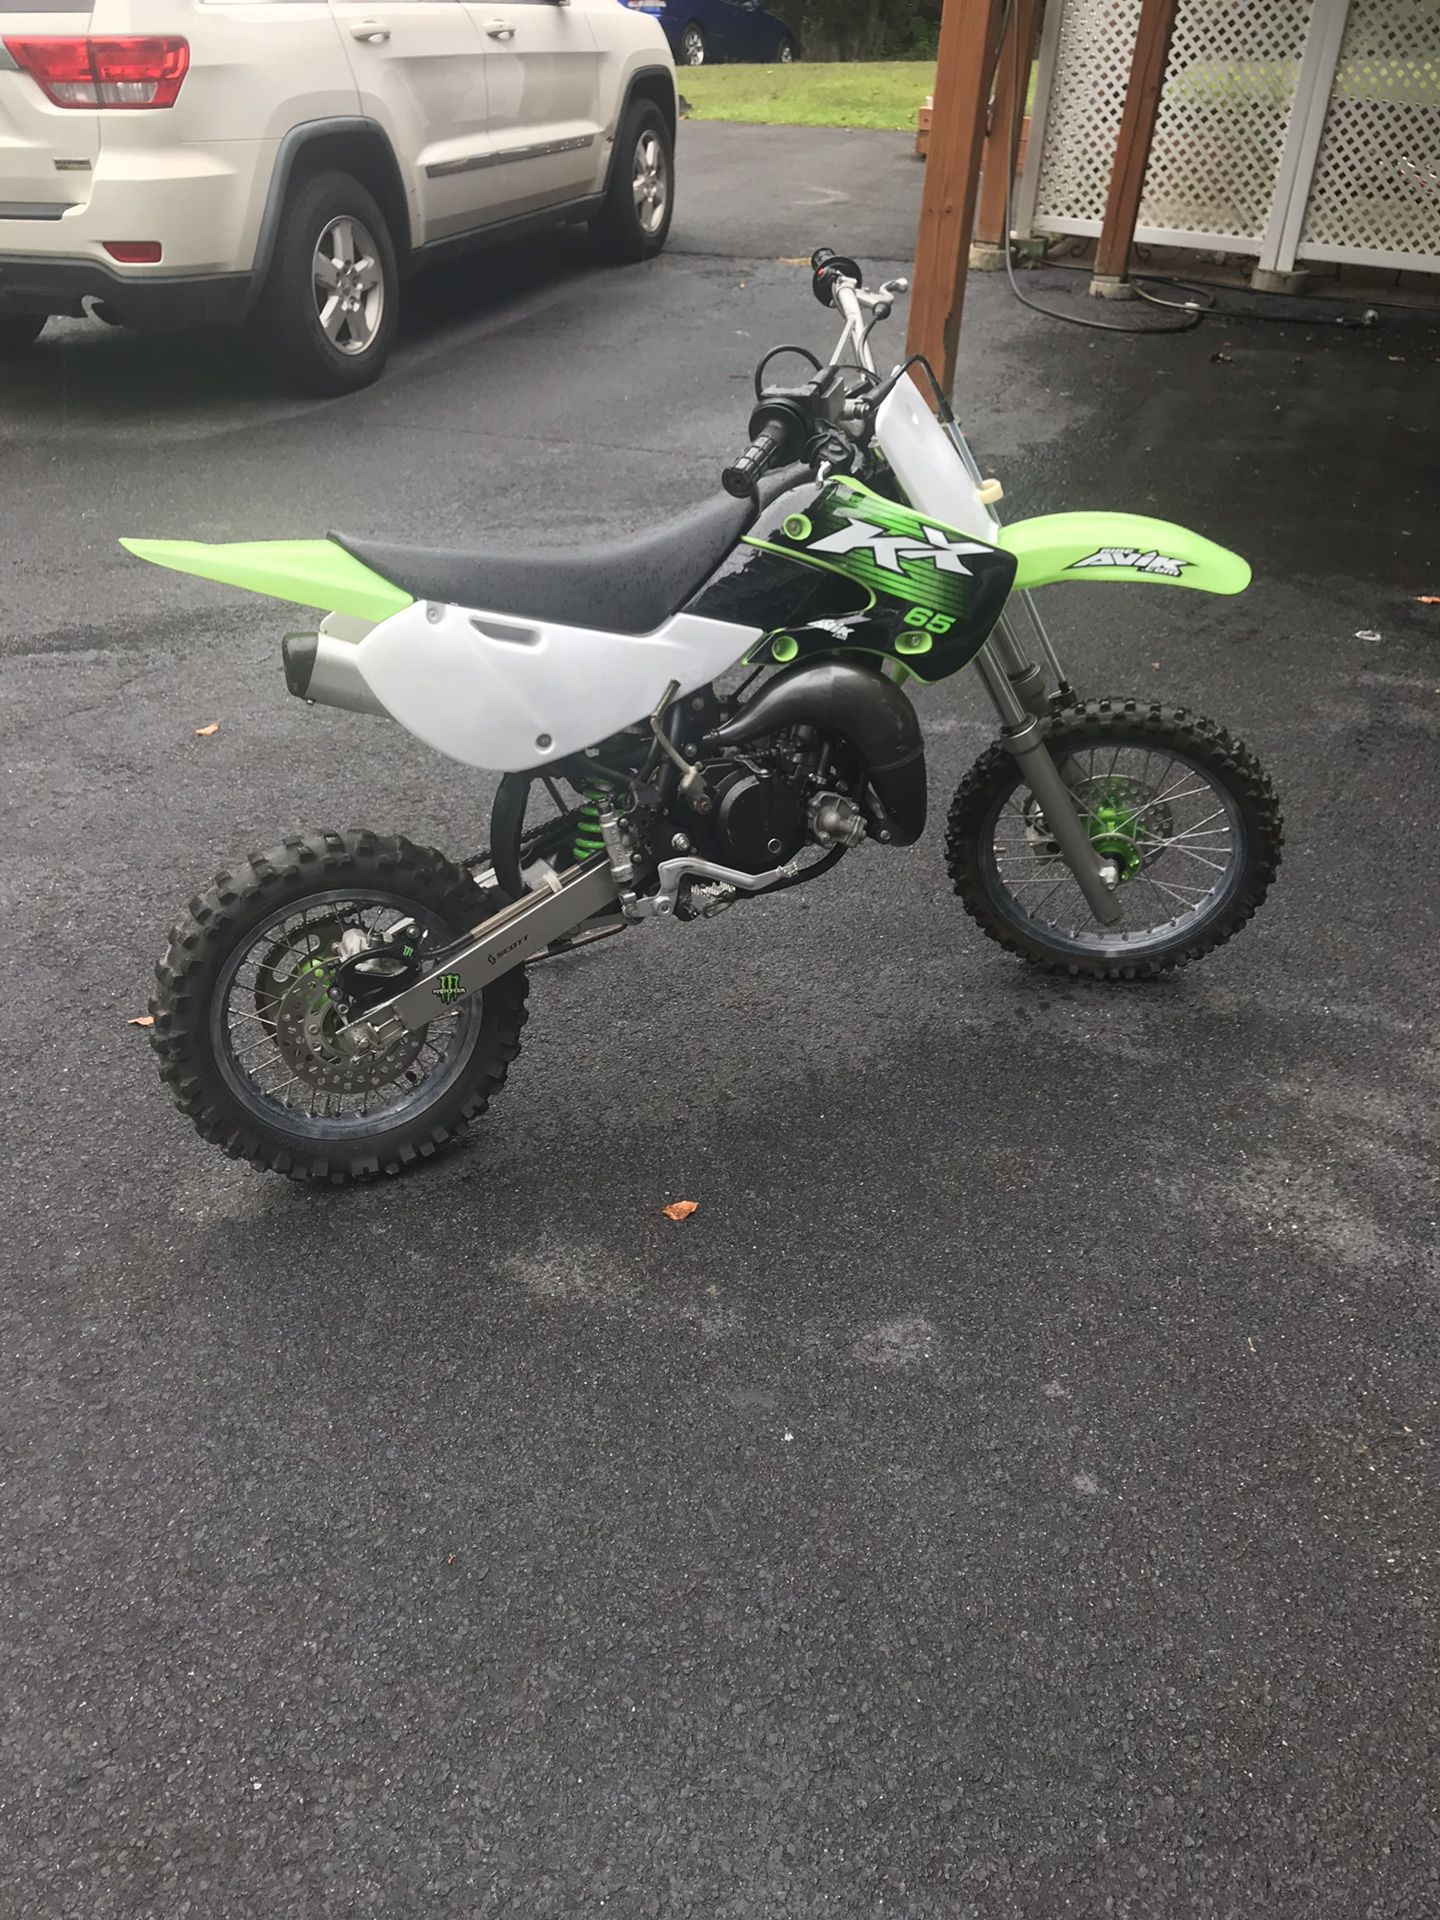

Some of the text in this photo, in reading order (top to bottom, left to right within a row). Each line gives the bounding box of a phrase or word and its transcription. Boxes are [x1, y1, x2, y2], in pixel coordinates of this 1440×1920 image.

[806, 517, 995, 577] KX
[903, 606, 957, 634] 65
[496, 934, 529, 959] SCOTT
